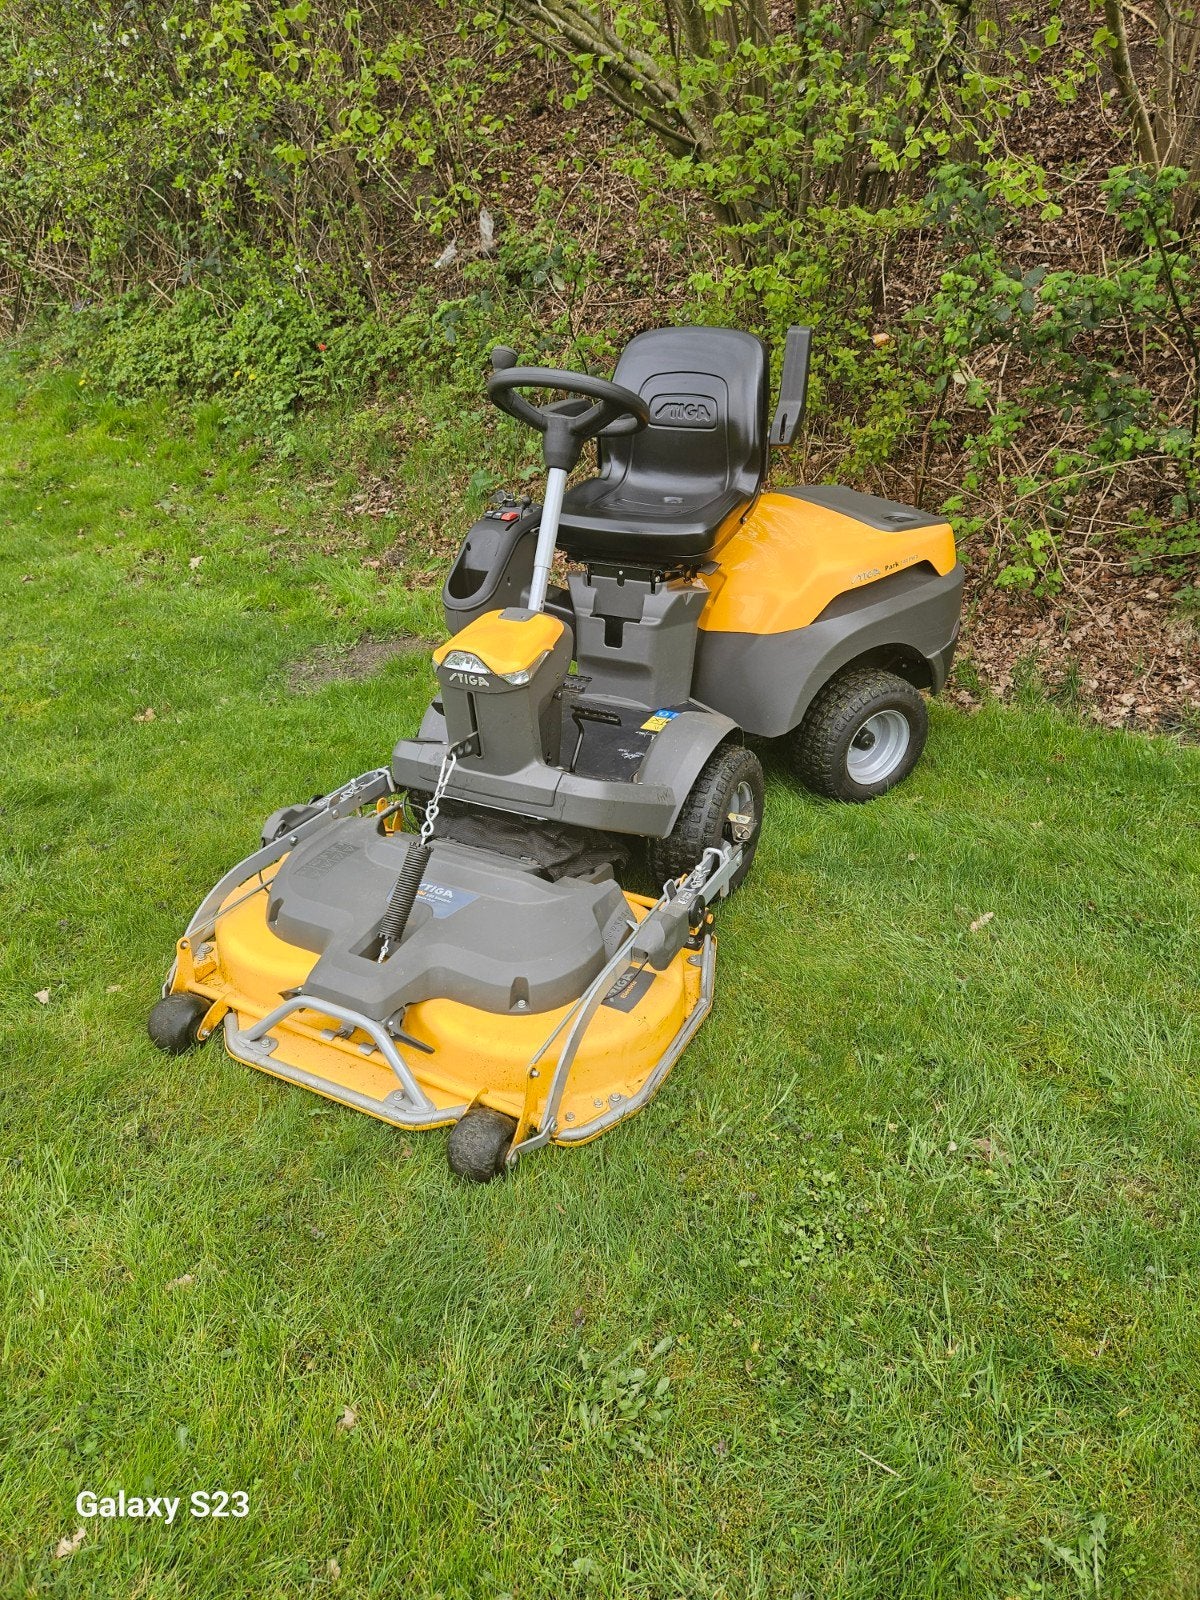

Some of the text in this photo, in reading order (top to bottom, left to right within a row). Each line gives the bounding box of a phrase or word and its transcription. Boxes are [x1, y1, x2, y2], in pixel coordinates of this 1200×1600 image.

[655, 402, 711, 422] STIGA
[884, 561, 899, 571] Park
[449, 672, 490, 687] STIGA
